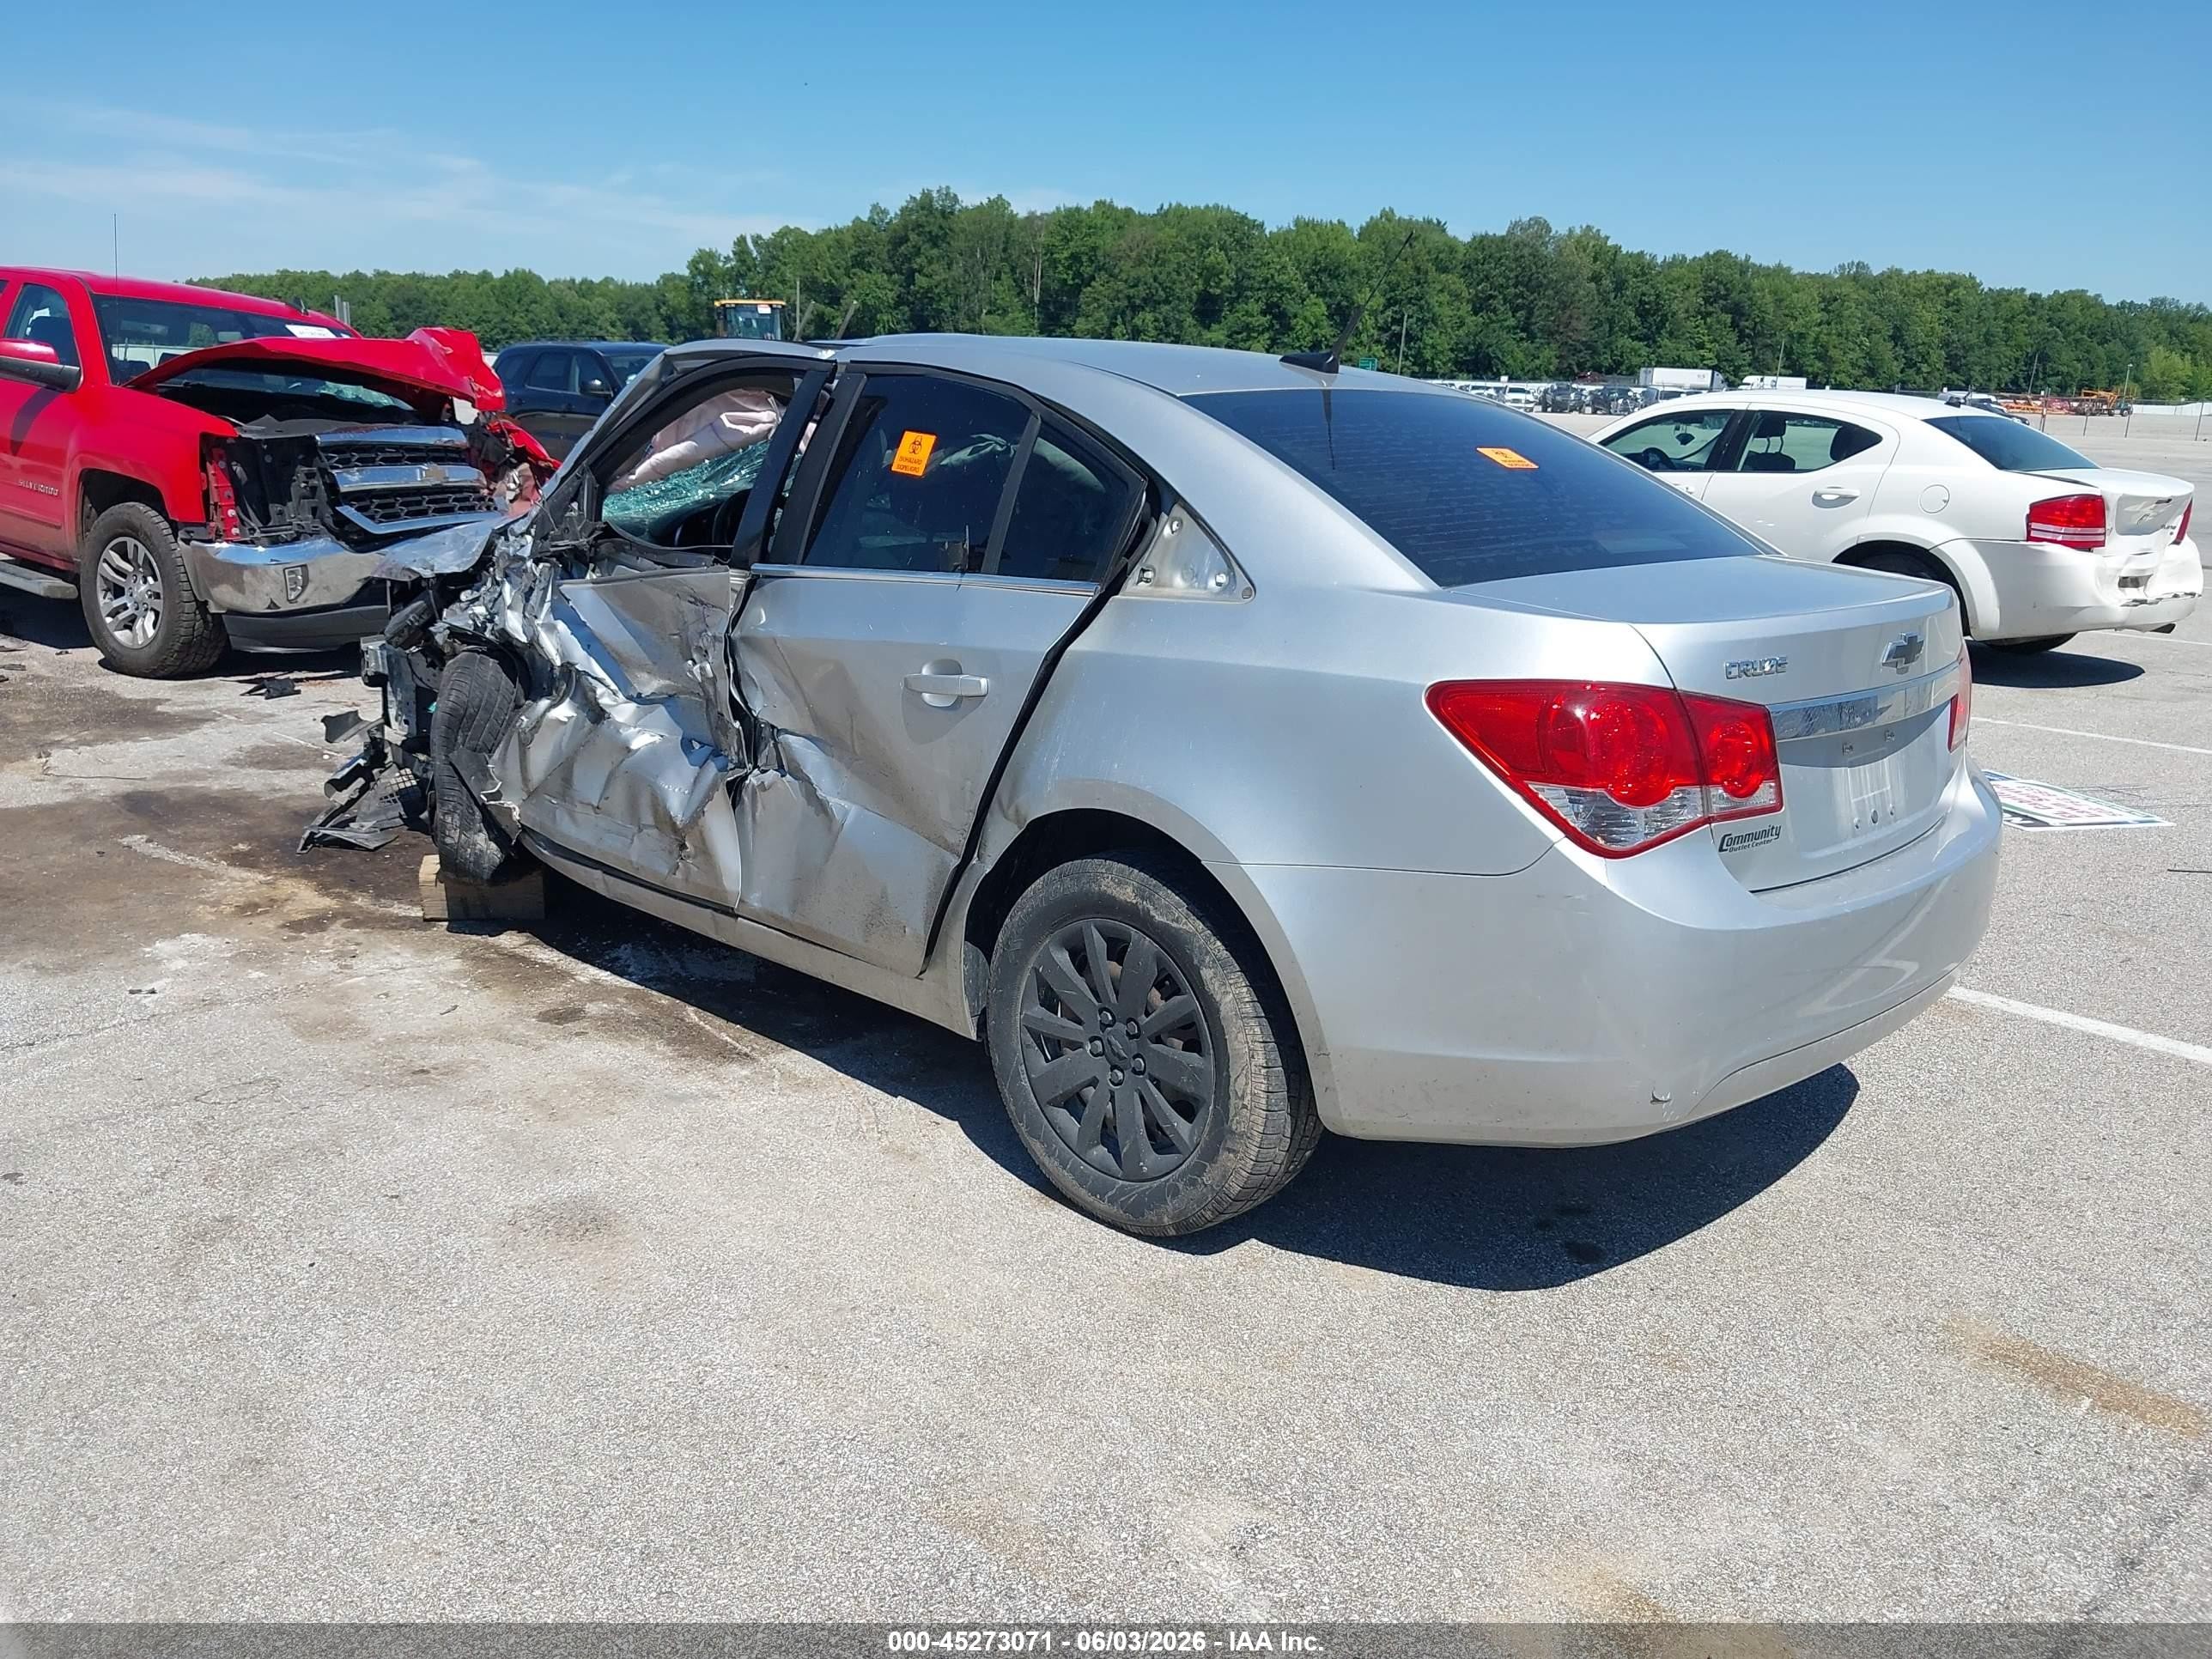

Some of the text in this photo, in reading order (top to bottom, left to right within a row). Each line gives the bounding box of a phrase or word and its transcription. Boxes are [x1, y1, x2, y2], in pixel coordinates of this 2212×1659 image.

[1724, 657, 1788, 679] CRUZE
[1718, 824, 1782, 852] Community
[1729, 839, 1772, 852] Outlet Center
